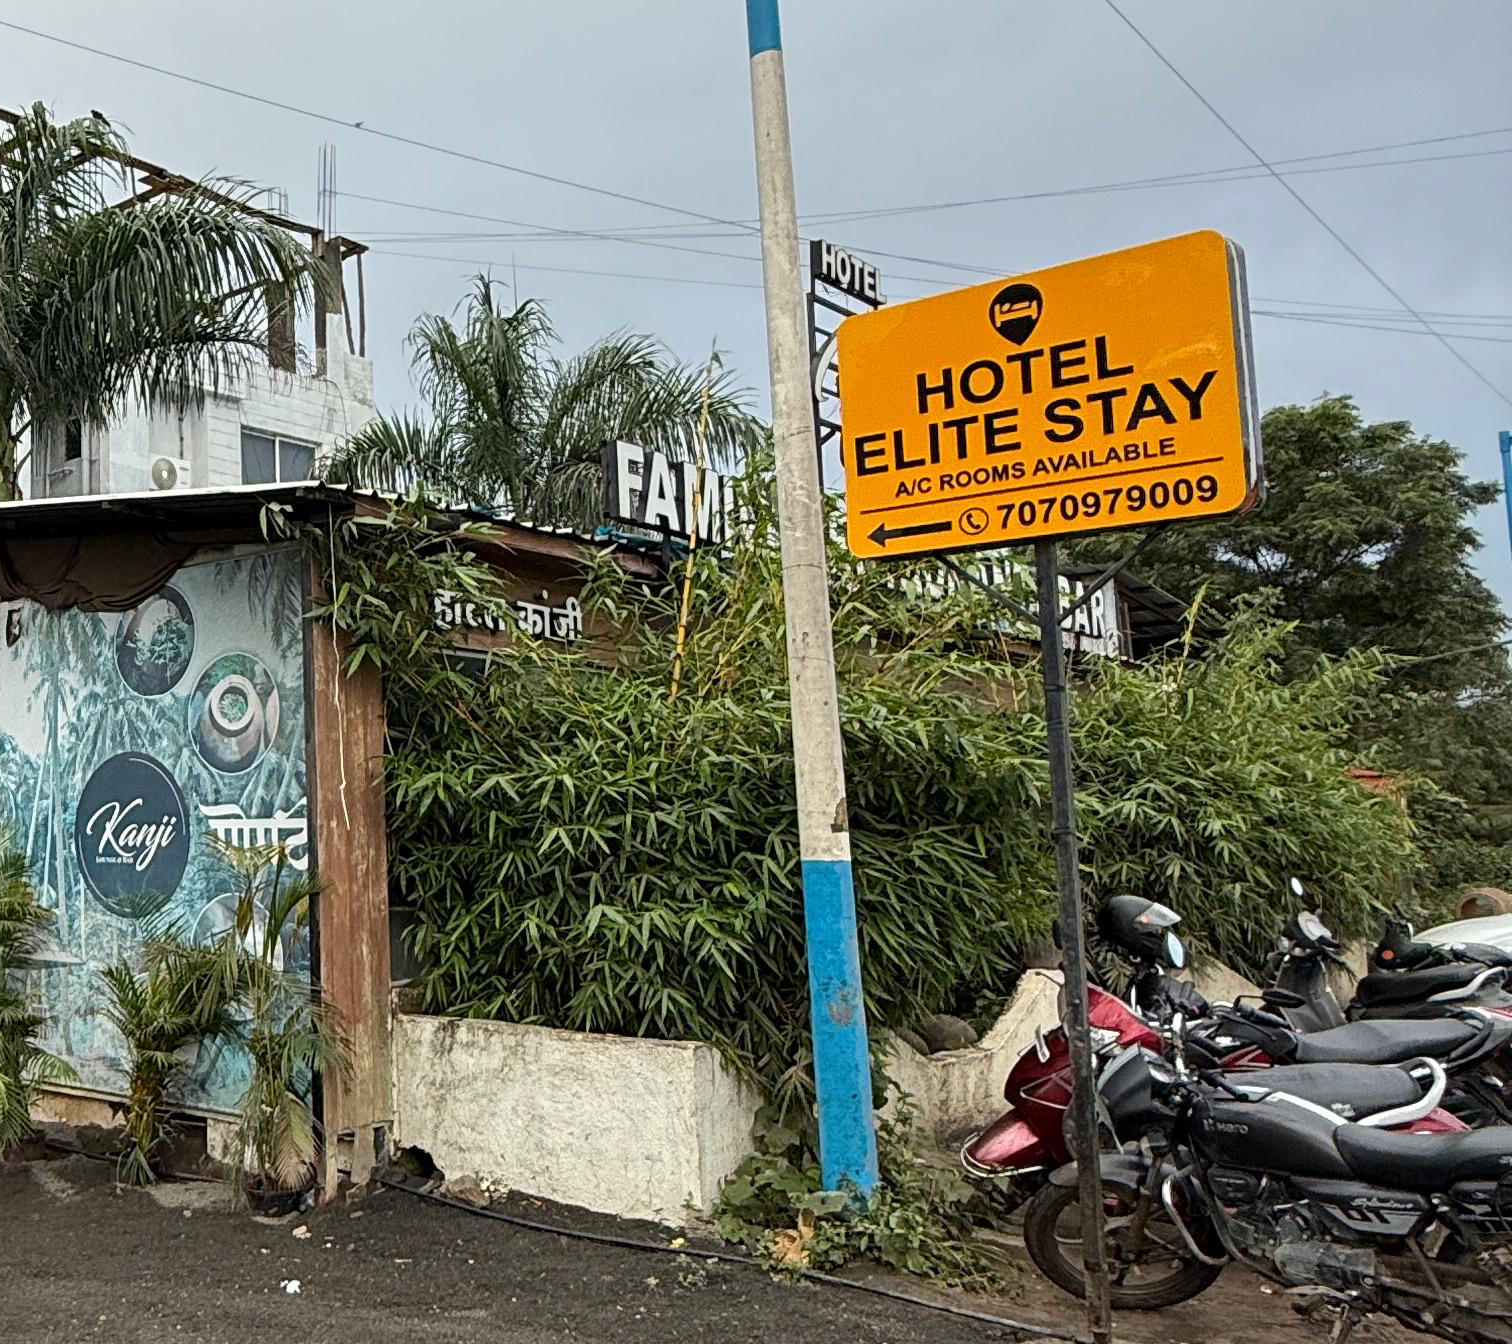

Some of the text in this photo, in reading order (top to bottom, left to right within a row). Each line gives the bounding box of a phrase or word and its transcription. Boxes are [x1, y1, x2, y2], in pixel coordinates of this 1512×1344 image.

[821, 239, 887, 305] HOTEL
[916, 335, 1134, 414] HOTEL
[855, 369, 1219, 477] ELITE STAY
[895, 436, 1176, 499] A/C ROOMS AVAILABLE
[996, 475, 1219, 530] 7070979009
[86, 798, 177, 872] Kanji
